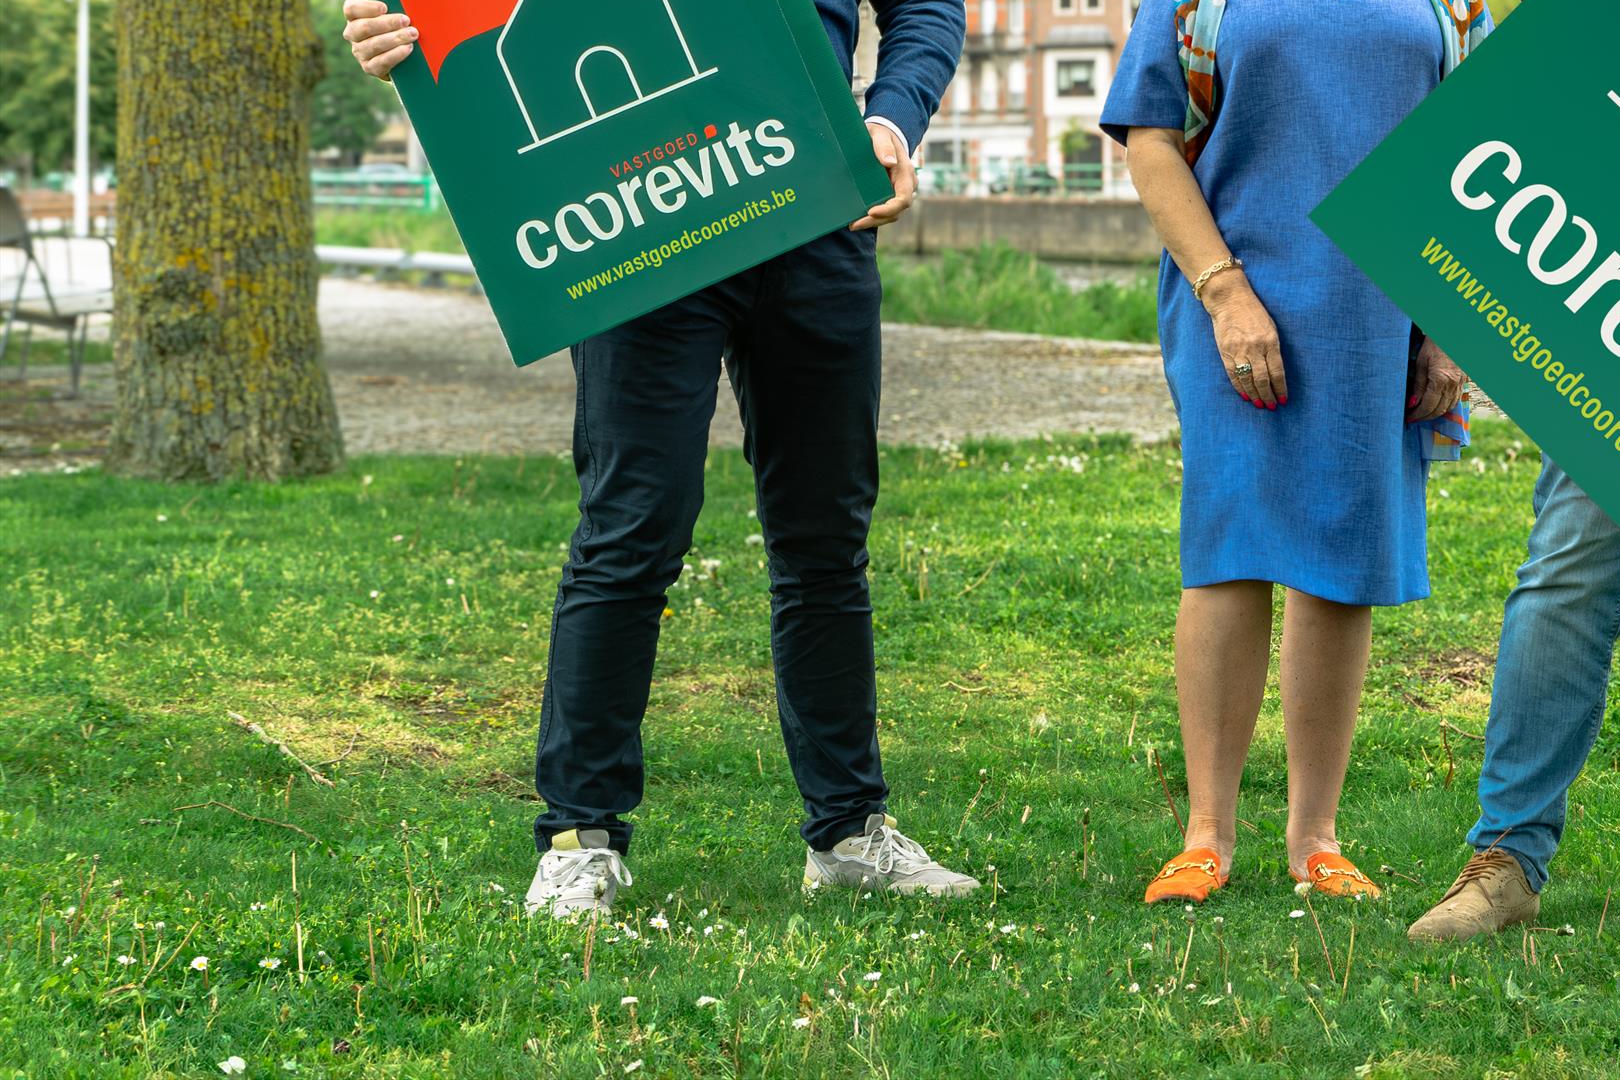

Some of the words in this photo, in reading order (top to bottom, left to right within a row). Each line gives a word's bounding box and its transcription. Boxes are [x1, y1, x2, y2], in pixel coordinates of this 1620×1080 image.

[516, 119, 795, 269] coorevits
[609, 133, 698, 178] VASTGOED
[567, 188, 796, 301] www.vastgoedcoorevits.be
